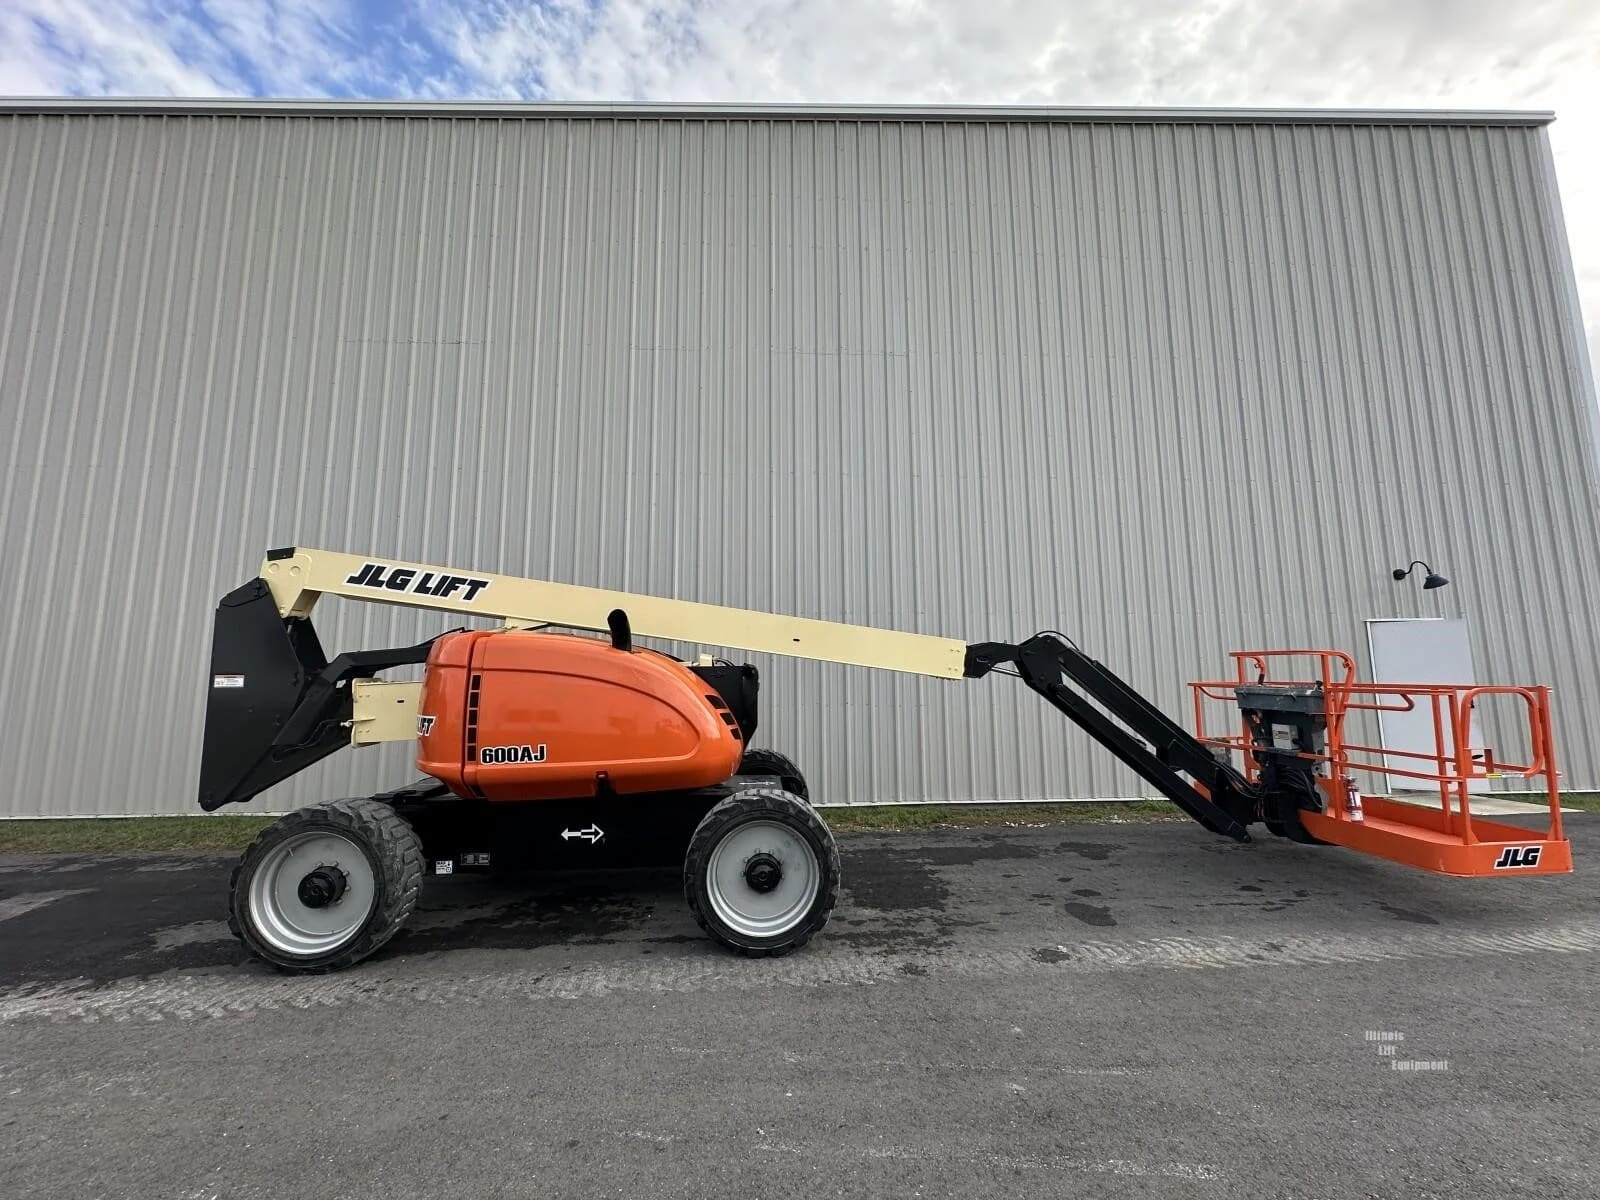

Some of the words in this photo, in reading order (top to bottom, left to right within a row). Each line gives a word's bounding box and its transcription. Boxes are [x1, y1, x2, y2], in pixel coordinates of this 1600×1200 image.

[346, 563, 417, 591] JLG
[412, 572, 490, 601] LIFT
[481, 744, 546, 764] 600AJ
[1494, 846, 1542, 869] JLG
